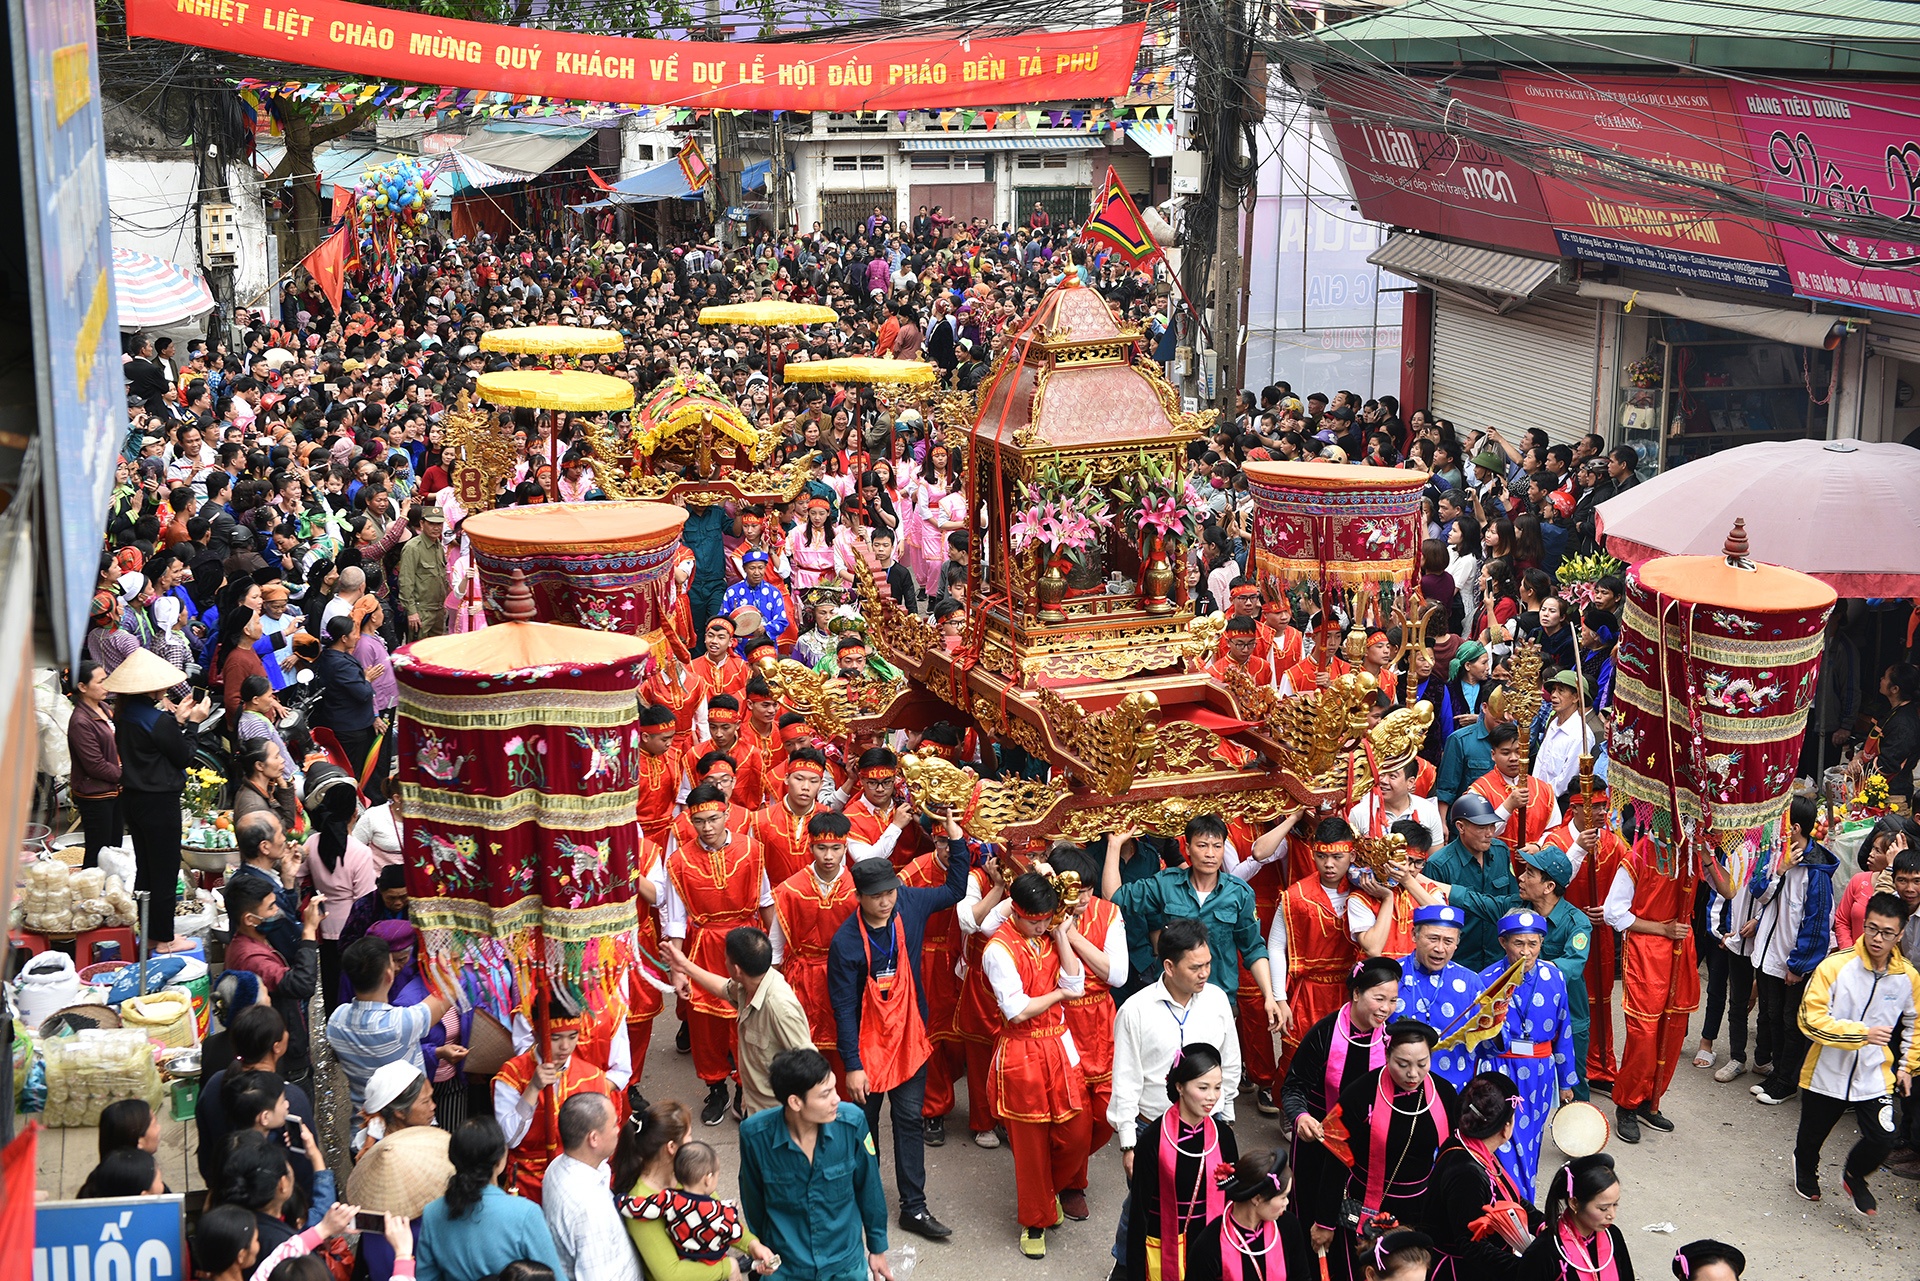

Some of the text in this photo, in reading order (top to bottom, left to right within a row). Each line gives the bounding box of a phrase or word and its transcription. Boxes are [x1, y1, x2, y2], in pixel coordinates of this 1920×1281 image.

[263, 8, 314, 41] LIỆT
[329, 20, 395, 51] CHÀO
[409, 29, 482, 64] MỪNG
[495, 43, 542, 71] QUÝ
[556, 50, 635, 79] KHÁCH
[649, 52, 679, 82] VỀ
[692, 60, 727, 89] DỰ
[739, 53, 765, 84] LỄ
[778, 59, 816, 90] HỘI
[828, 55, 873, 86] ĐẦU
[889, 58, 947, 85] PHÁO
[962, 51, 1006, 82] ĐỀN
[1018, 46, 1042, 77] TẢ
[1056, 44, 1099, 74] PHỦ
[1746, 93, 1782, 115] HÀNG
[1781, 95, 1812, 117] TIÊU
[1447, 183, 1469, 200] trang
[1462, 166, 1518, 204] men
[1618, 202, 1674, 238] PHÒNG
